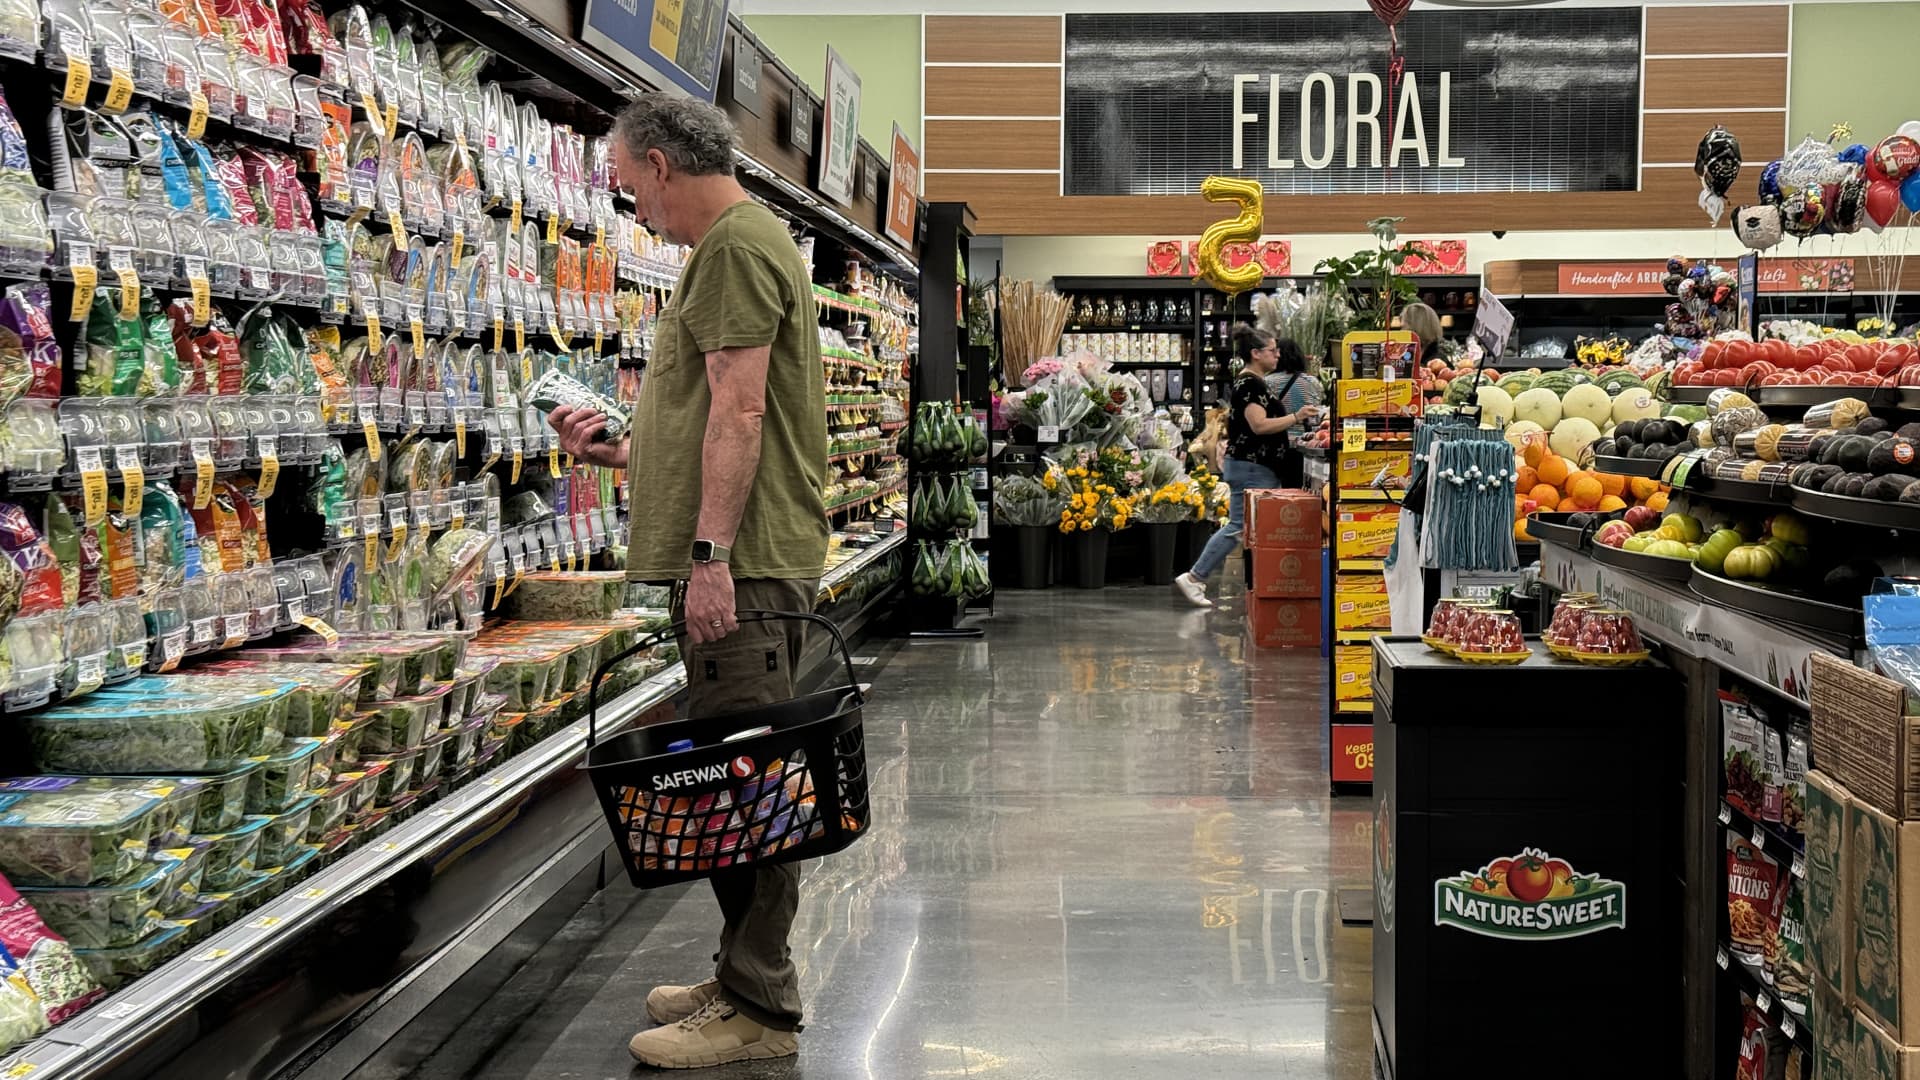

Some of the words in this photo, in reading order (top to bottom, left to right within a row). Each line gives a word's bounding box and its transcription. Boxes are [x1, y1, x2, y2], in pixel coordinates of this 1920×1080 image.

[1232, 71, 1466, 170] FLORAL
[1571, 270, 1634, 290] Handcrafted
[1345, 742, 1374, 756] Keep
[652, 762, 729, 792] SAFEWAY
[1732, 863, 1760, 878] CRISPY
[1728, 874, 1770, 900] NIONS
